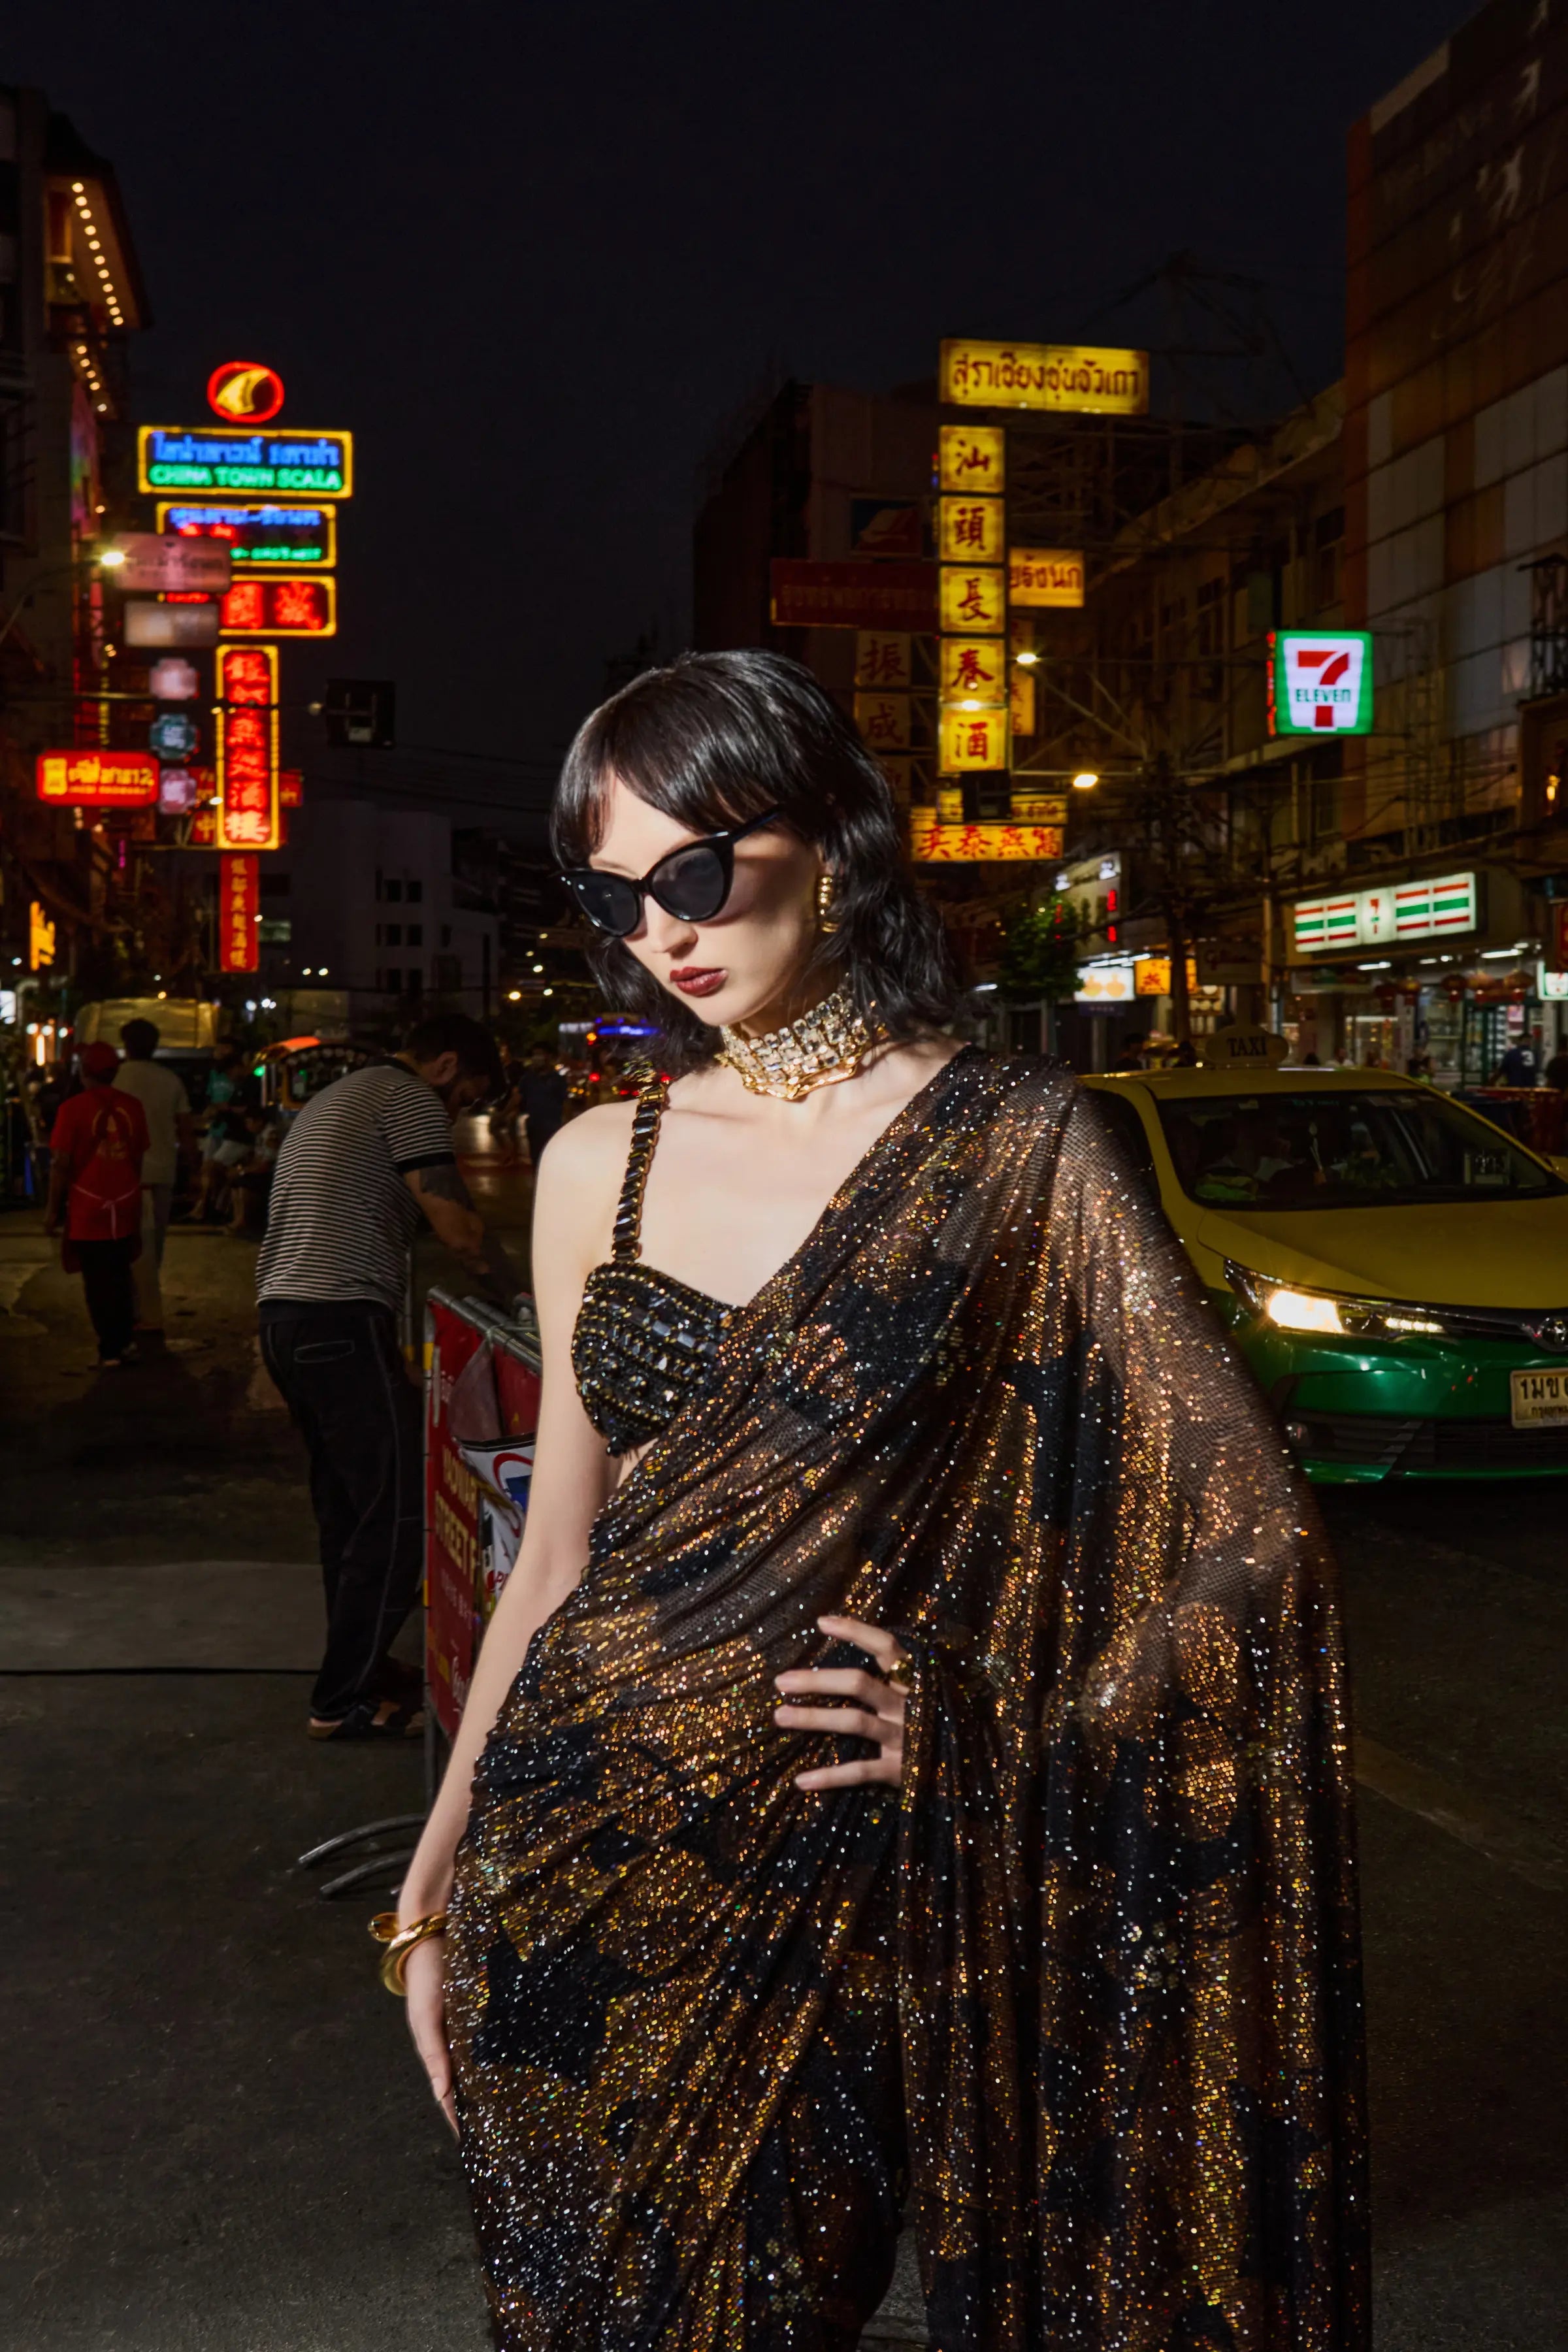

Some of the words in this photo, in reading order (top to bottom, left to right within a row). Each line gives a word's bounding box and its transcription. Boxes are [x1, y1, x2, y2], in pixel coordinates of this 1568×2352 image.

[150, 465, 212, 485] CHINA
[214, 466, 274, 487] TOWN
[277, 468, 342, 491] SCALA
[953, 440, 994, 760] 汕頭長春酒
[860, 639, 906, 786] 振成
[1297, 651, 1350, 727] 7
[1228, 1036, 1267, 1056] TAXI
[1520, 1377, 1559, 1399] 1มข
